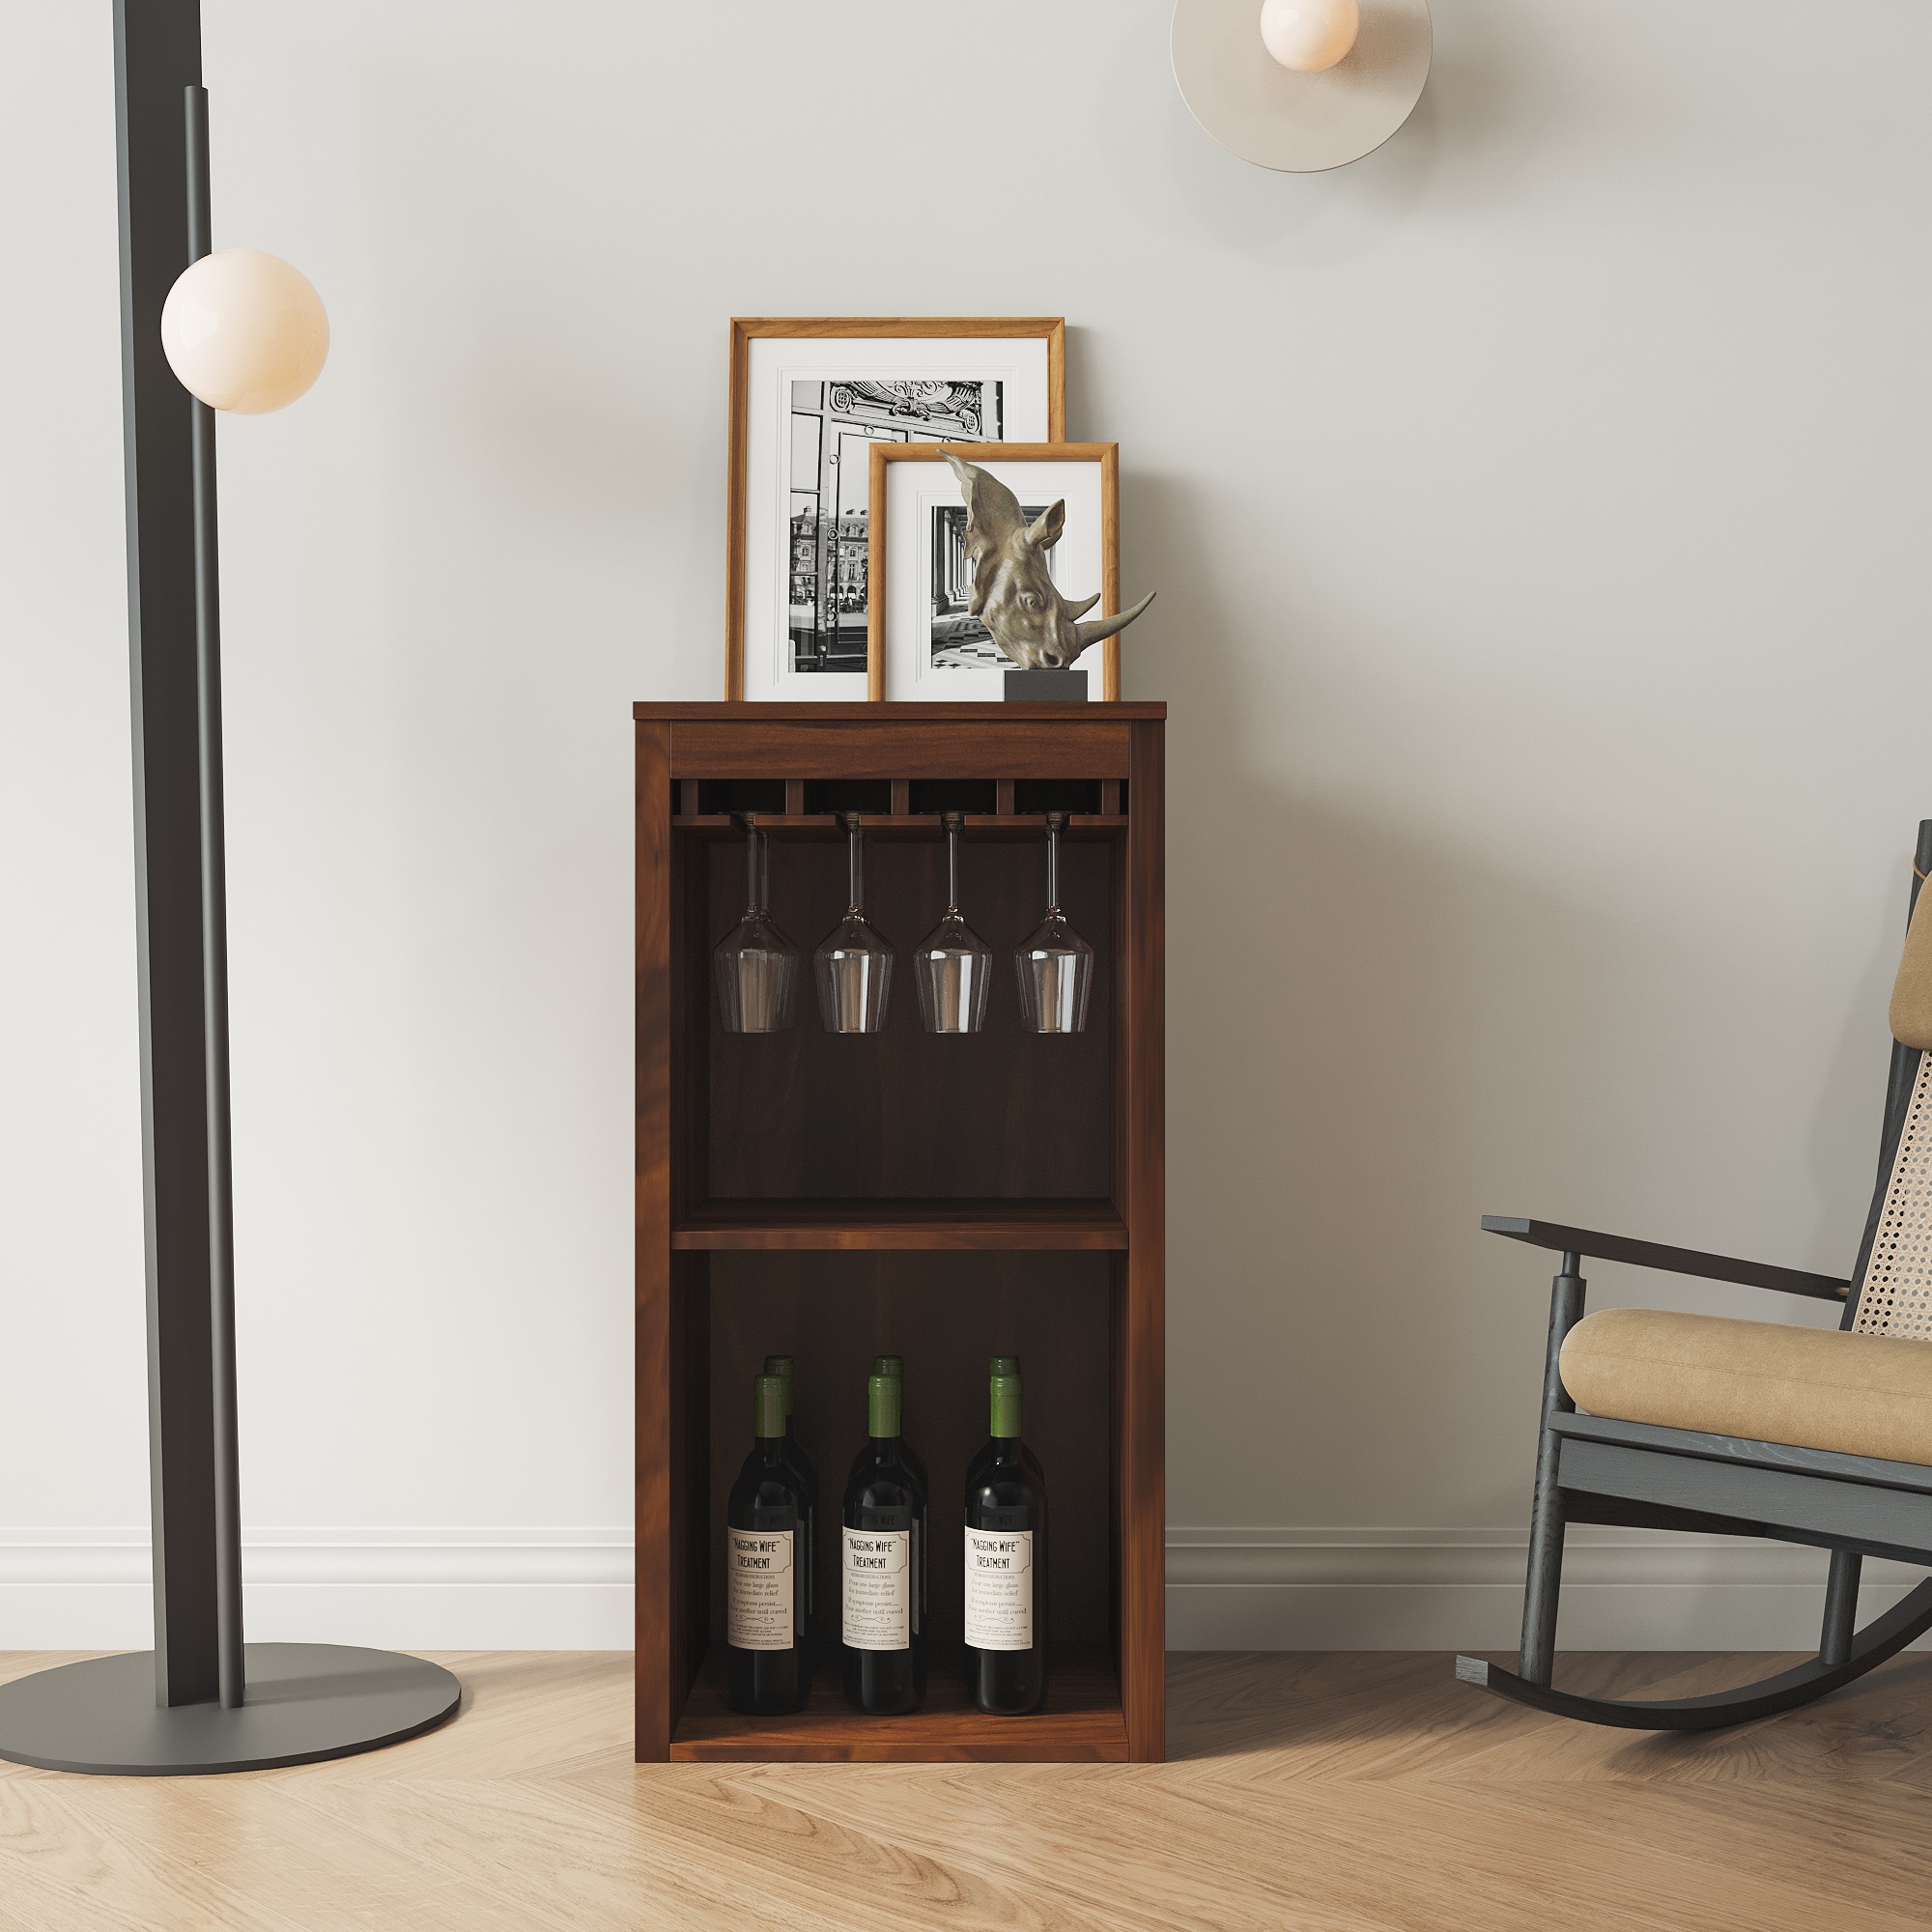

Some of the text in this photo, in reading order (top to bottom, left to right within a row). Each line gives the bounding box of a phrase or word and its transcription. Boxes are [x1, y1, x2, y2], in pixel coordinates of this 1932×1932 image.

[737, 1554, 770, 1569] TREATMENT
[853, 1554, 886, 1569] TREATMENT
[977, 1554, 1010, 1569] TREATMENT
